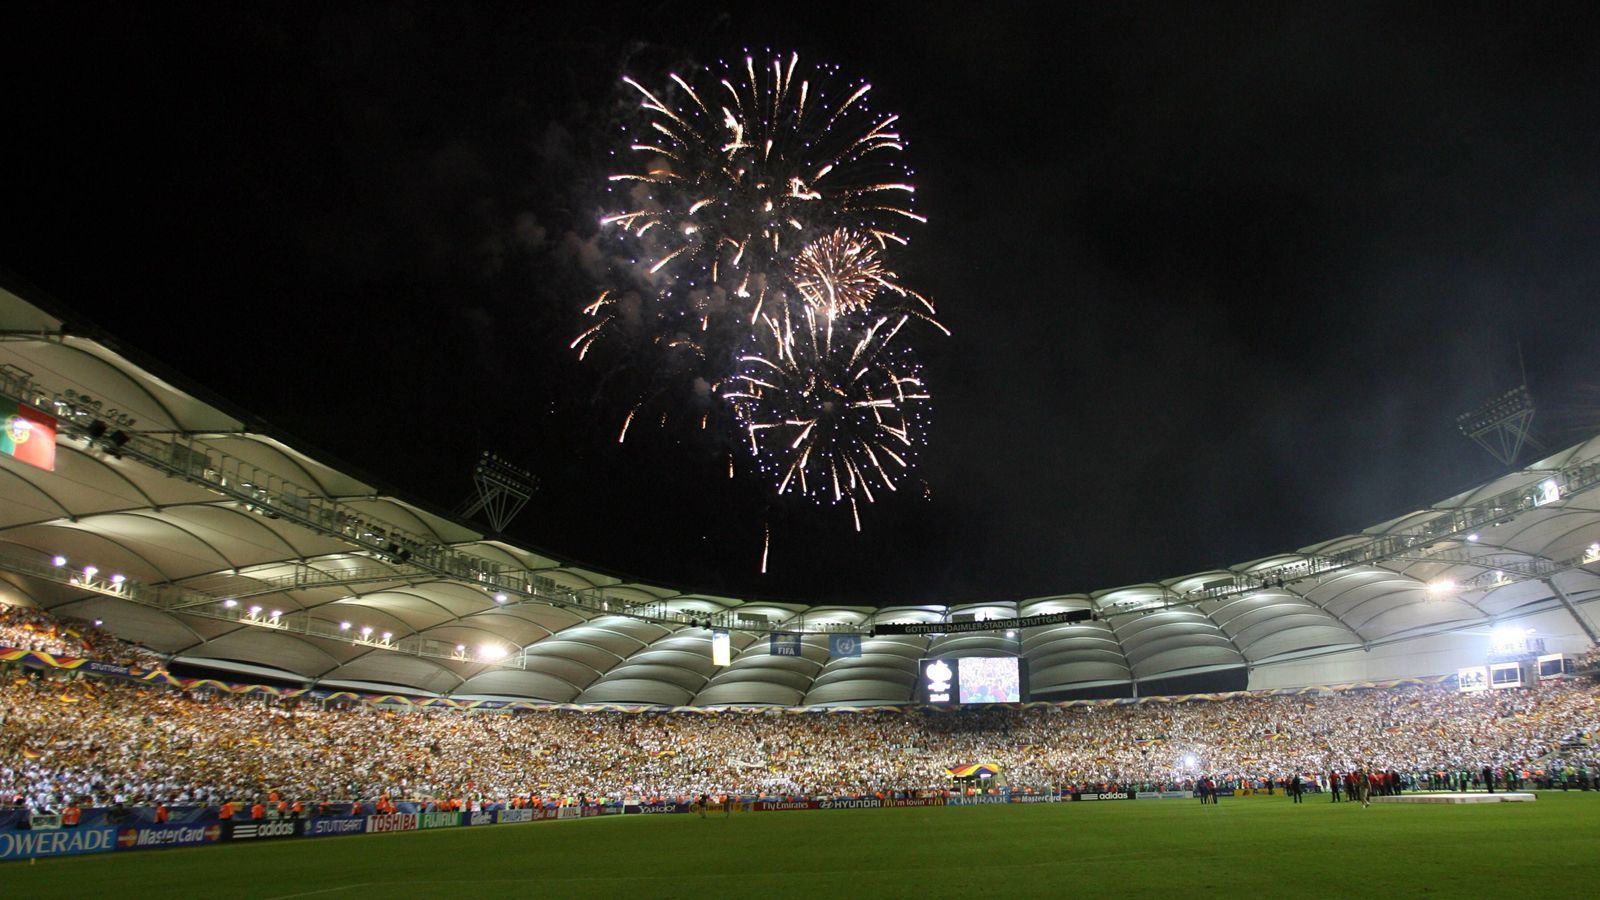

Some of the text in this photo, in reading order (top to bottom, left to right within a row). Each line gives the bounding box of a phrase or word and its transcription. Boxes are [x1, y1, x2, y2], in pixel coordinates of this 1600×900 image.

[904, 613, 1069, 634] GOTTLIEB-DAIMLER-STADION STUTTGART
[777, 646, 795, 656] FIFA
[90, 662, 129, 674] STUTTGART
[1021, 794, 1061, 803] MasterCard
[1098, 791, 1128, 799] adidas
[834, 800, 881, 808] HYUNDAI
[257, 821, 295, 837] adidas
[316, 818, 364, 834] STUTTGART
[371, 813, 417, 831] TOSHIBA
[136, 826, 206, 846] MasterCard
